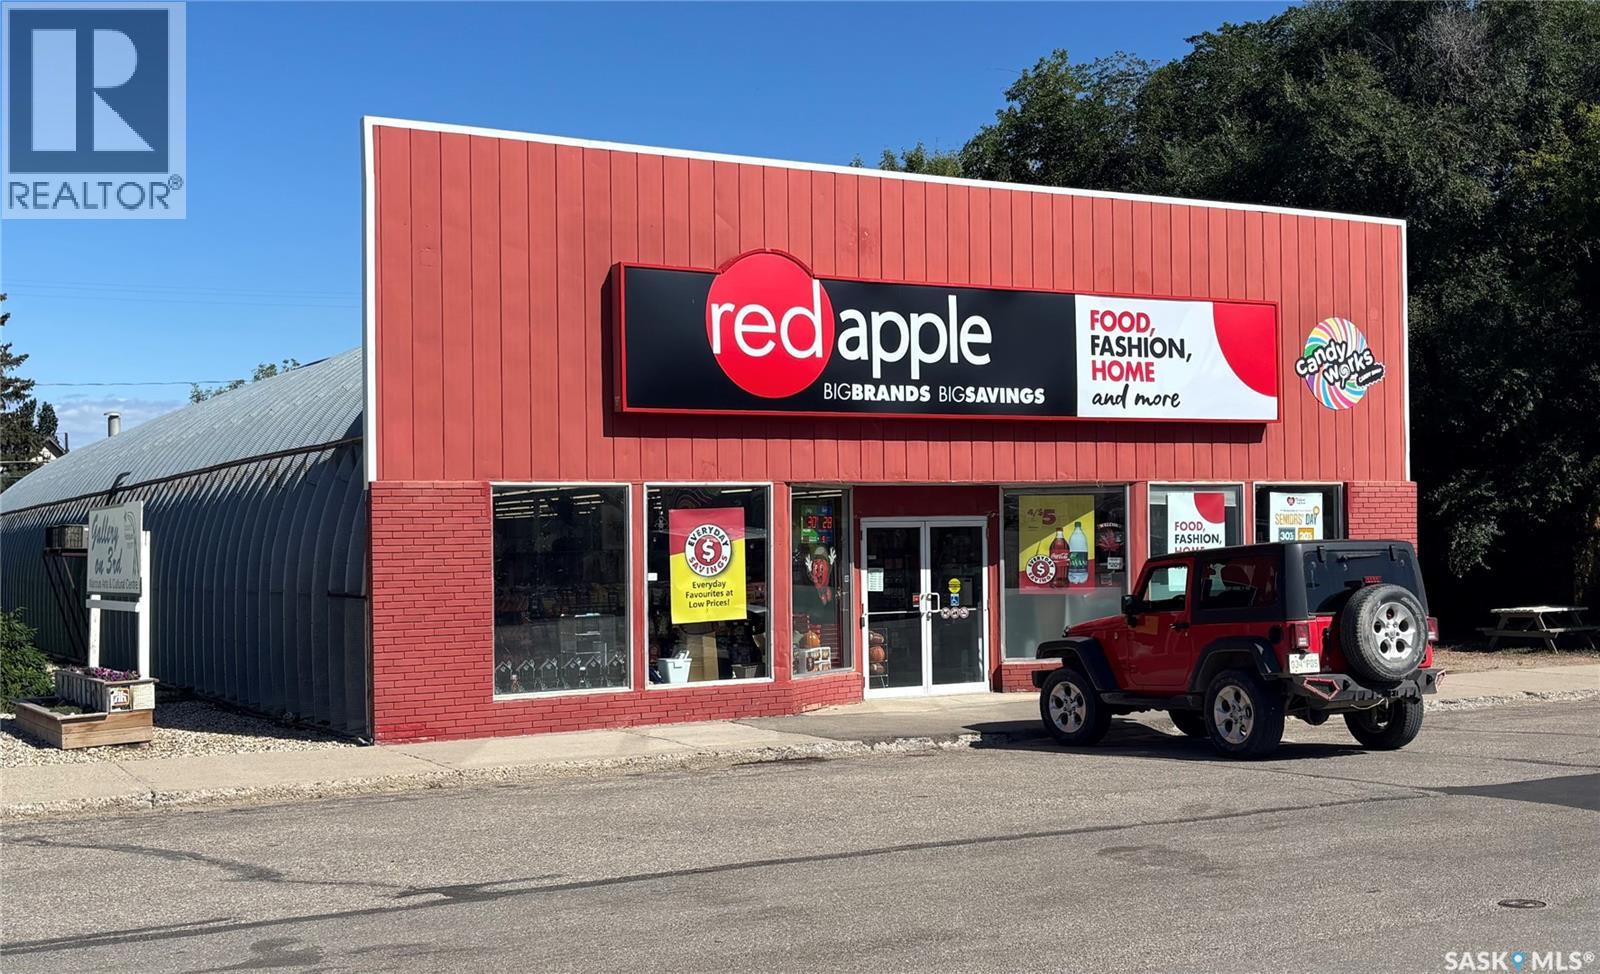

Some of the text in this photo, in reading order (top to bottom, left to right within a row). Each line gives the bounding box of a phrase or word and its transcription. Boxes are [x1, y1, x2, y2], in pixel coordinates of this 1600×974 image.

[710, 278, 993, 380] red apple
[1090, 309, 1155, 337] FOOD,
[1090, 335, 1192, 362] FASHION,
[1295, 340, 1347, 376] candy
[1091, 360, 1156, 382] HOME
[1092, 383, 1181, 409] and more
[1174, 521, 1206, 532] FOOD,
[1305, 513, 1318, 526] DAY
[688, 526, 729, 547] EVERYDAY
[1174, 533, 1223, 545] FASHION,
[689, 555, 728, 574] SAVINGS
[685, 590, 724, 599] Favourites
[692, 580, 726, 590] Everyday
[706, 599, 730, 608] Prices!
